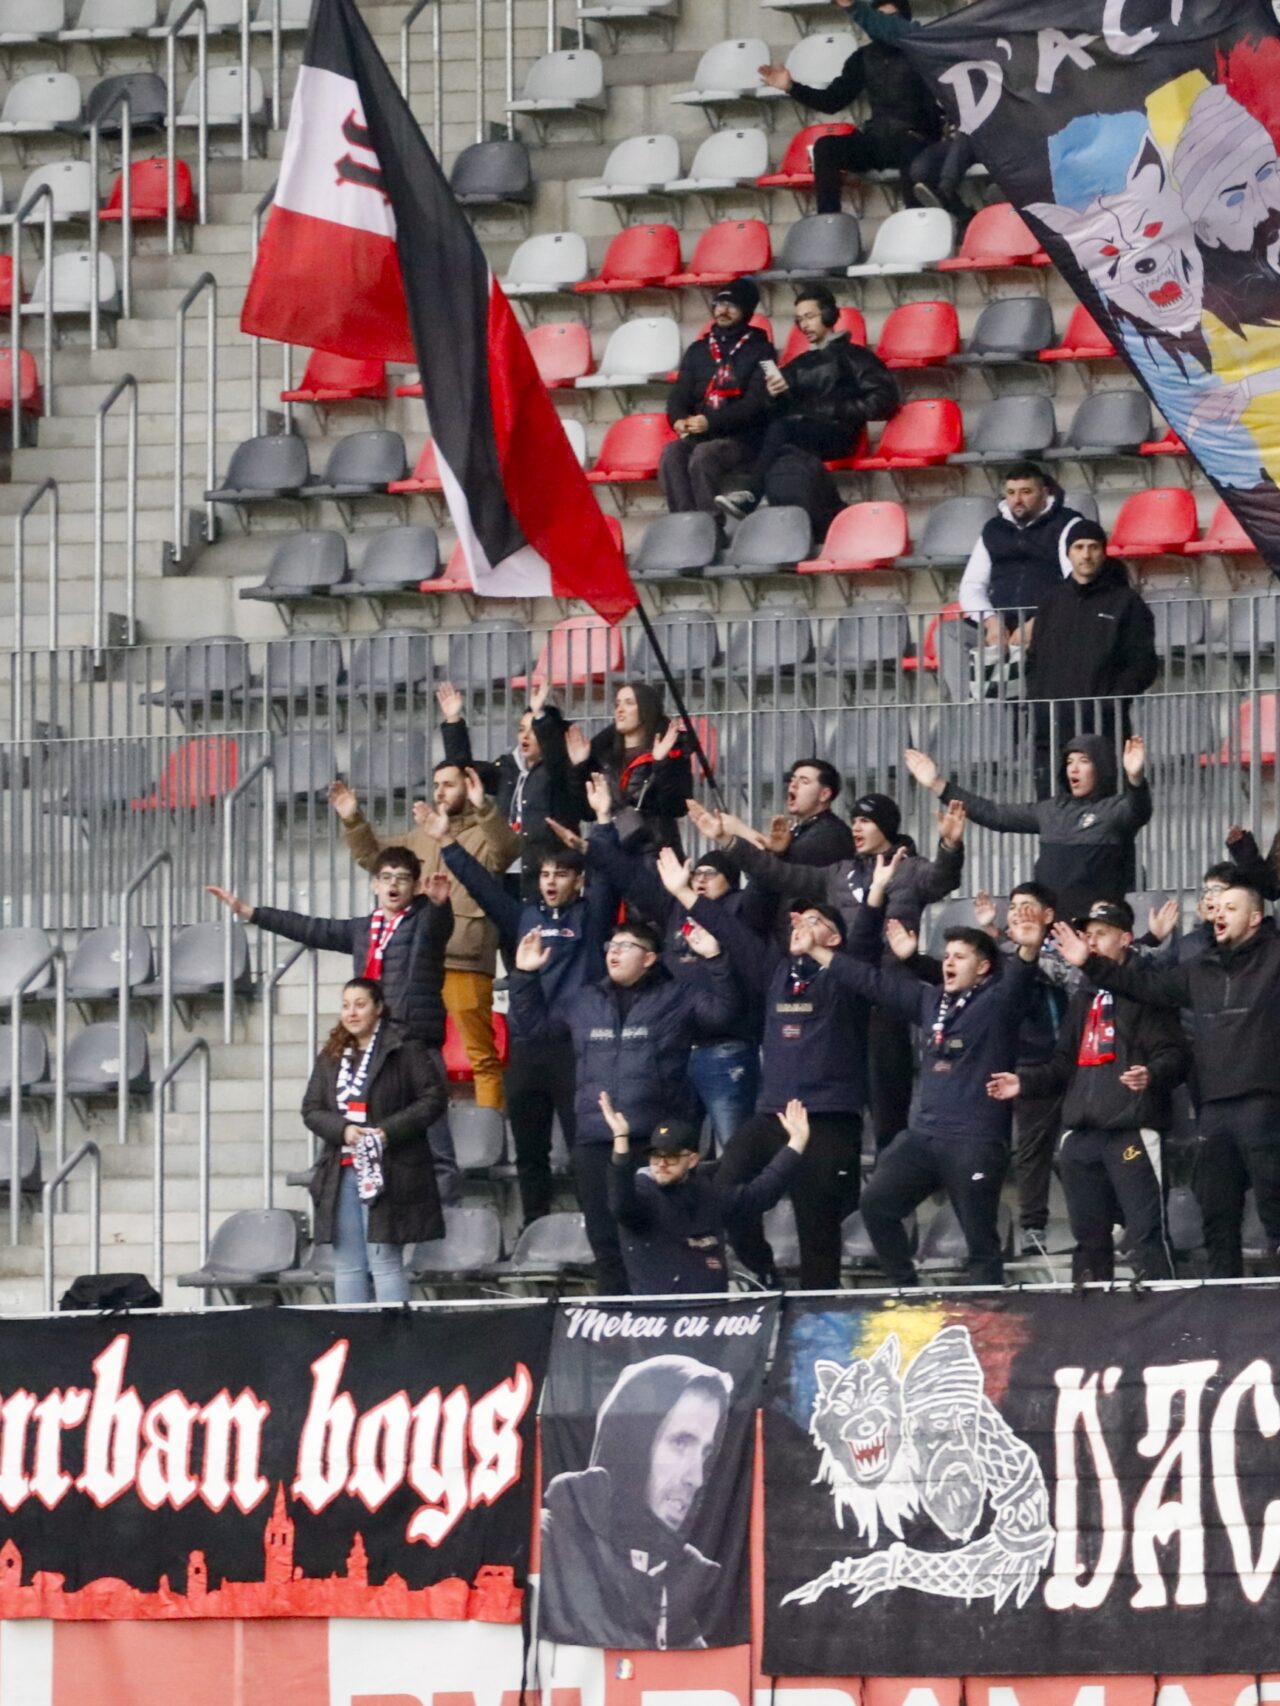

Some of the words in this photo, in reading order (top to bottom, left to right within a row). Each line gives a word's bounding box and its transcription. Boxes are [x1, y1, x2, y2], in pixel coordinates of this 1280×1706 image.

[564, 1307, 668, 1342] Mereu
[673, 1315, 710, 1338] cu
[713, 1306, 766, 1336] noi
[290, 1338, 534, 1548] boys
